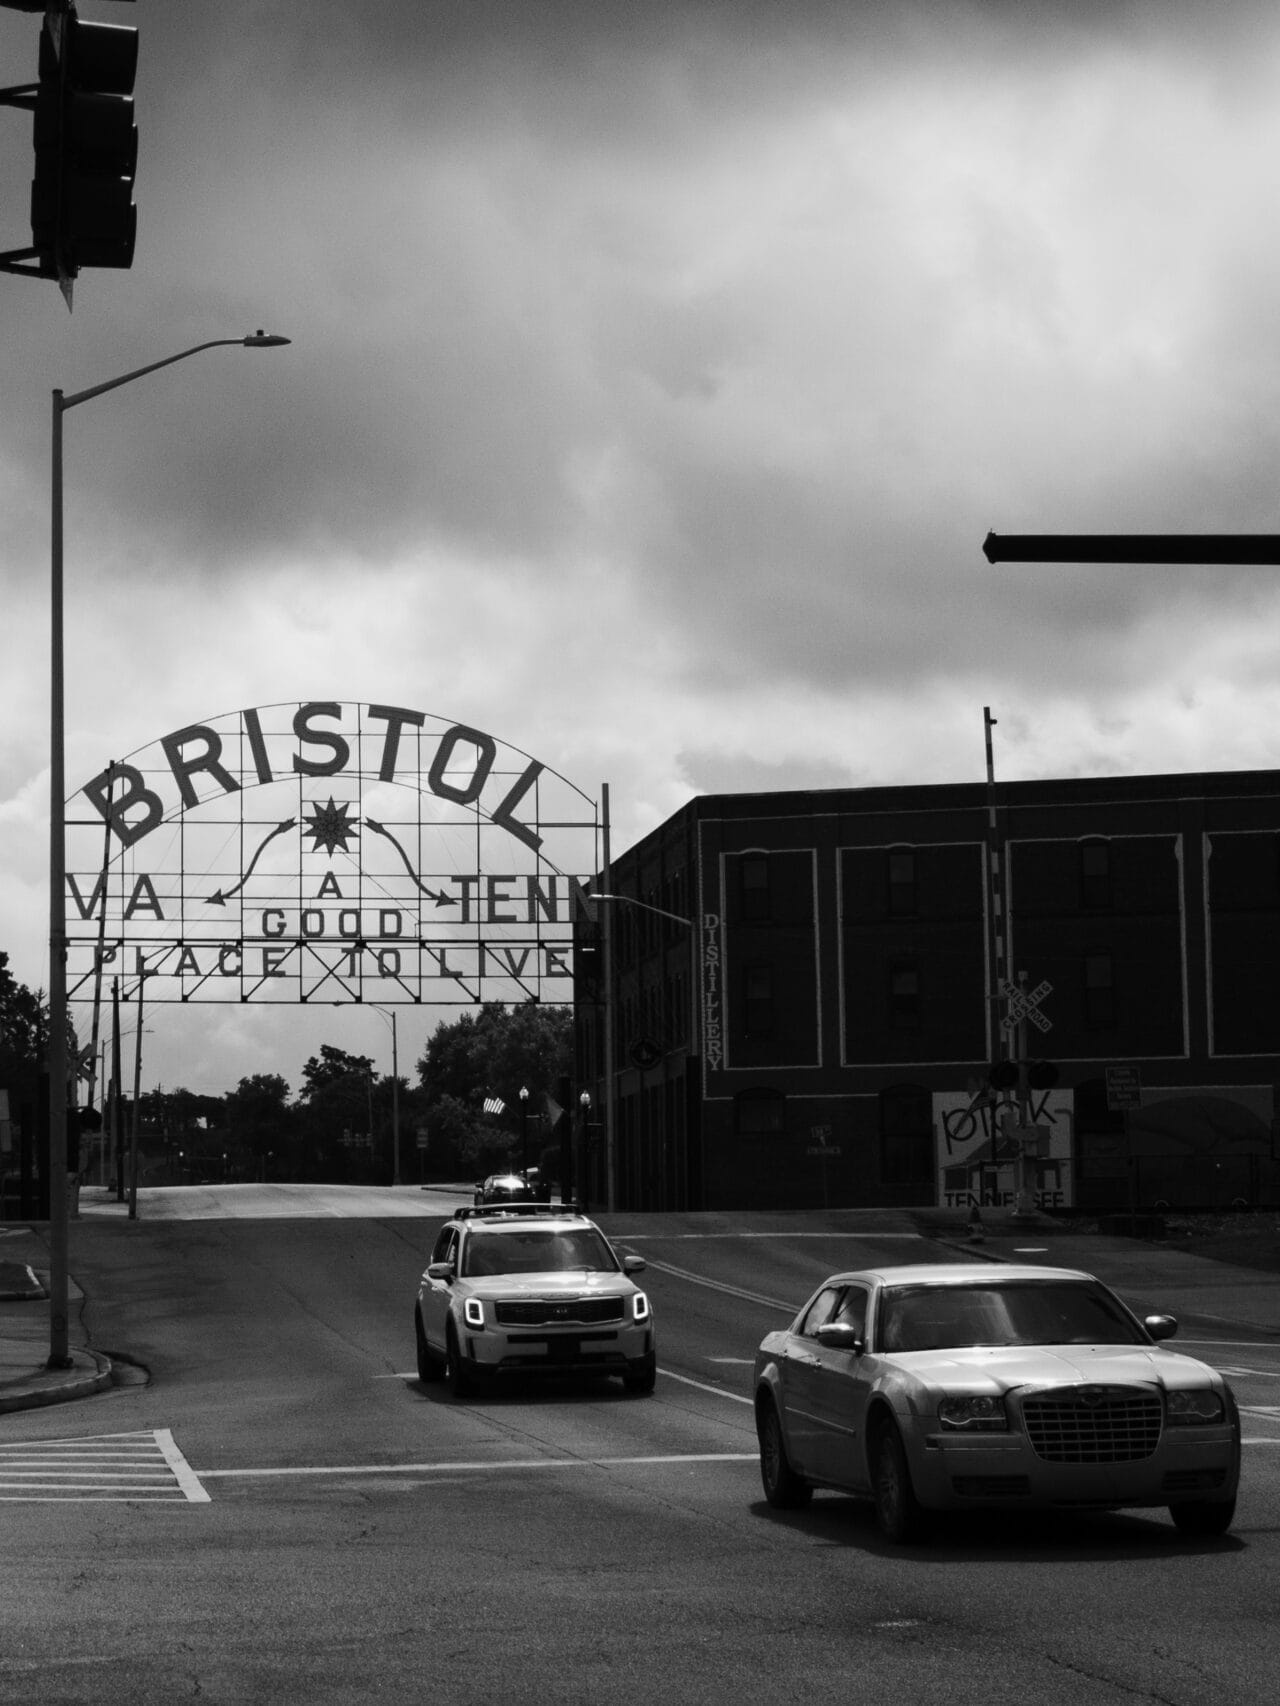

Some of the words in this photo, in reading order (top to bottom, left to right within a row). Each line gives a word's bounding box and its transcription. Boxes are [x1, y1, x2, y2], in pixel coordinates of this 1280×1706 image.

[82, 702, 545, 850] BRISTOL
[65, 873, 164, 920] VA
[317, 871, 342, 899] A
[451, 875, 599, 922] TENN
[262, 908, 402, 938] GOOD
[93, 945, 286, 977] PLACE
[341, 948, 401, 978] TO
[439, 948, 569, 978] LIVE
[704, 913, 723, 1072] DISTILLERY
[944, 1191, 1064, 1208] TENNESEE
